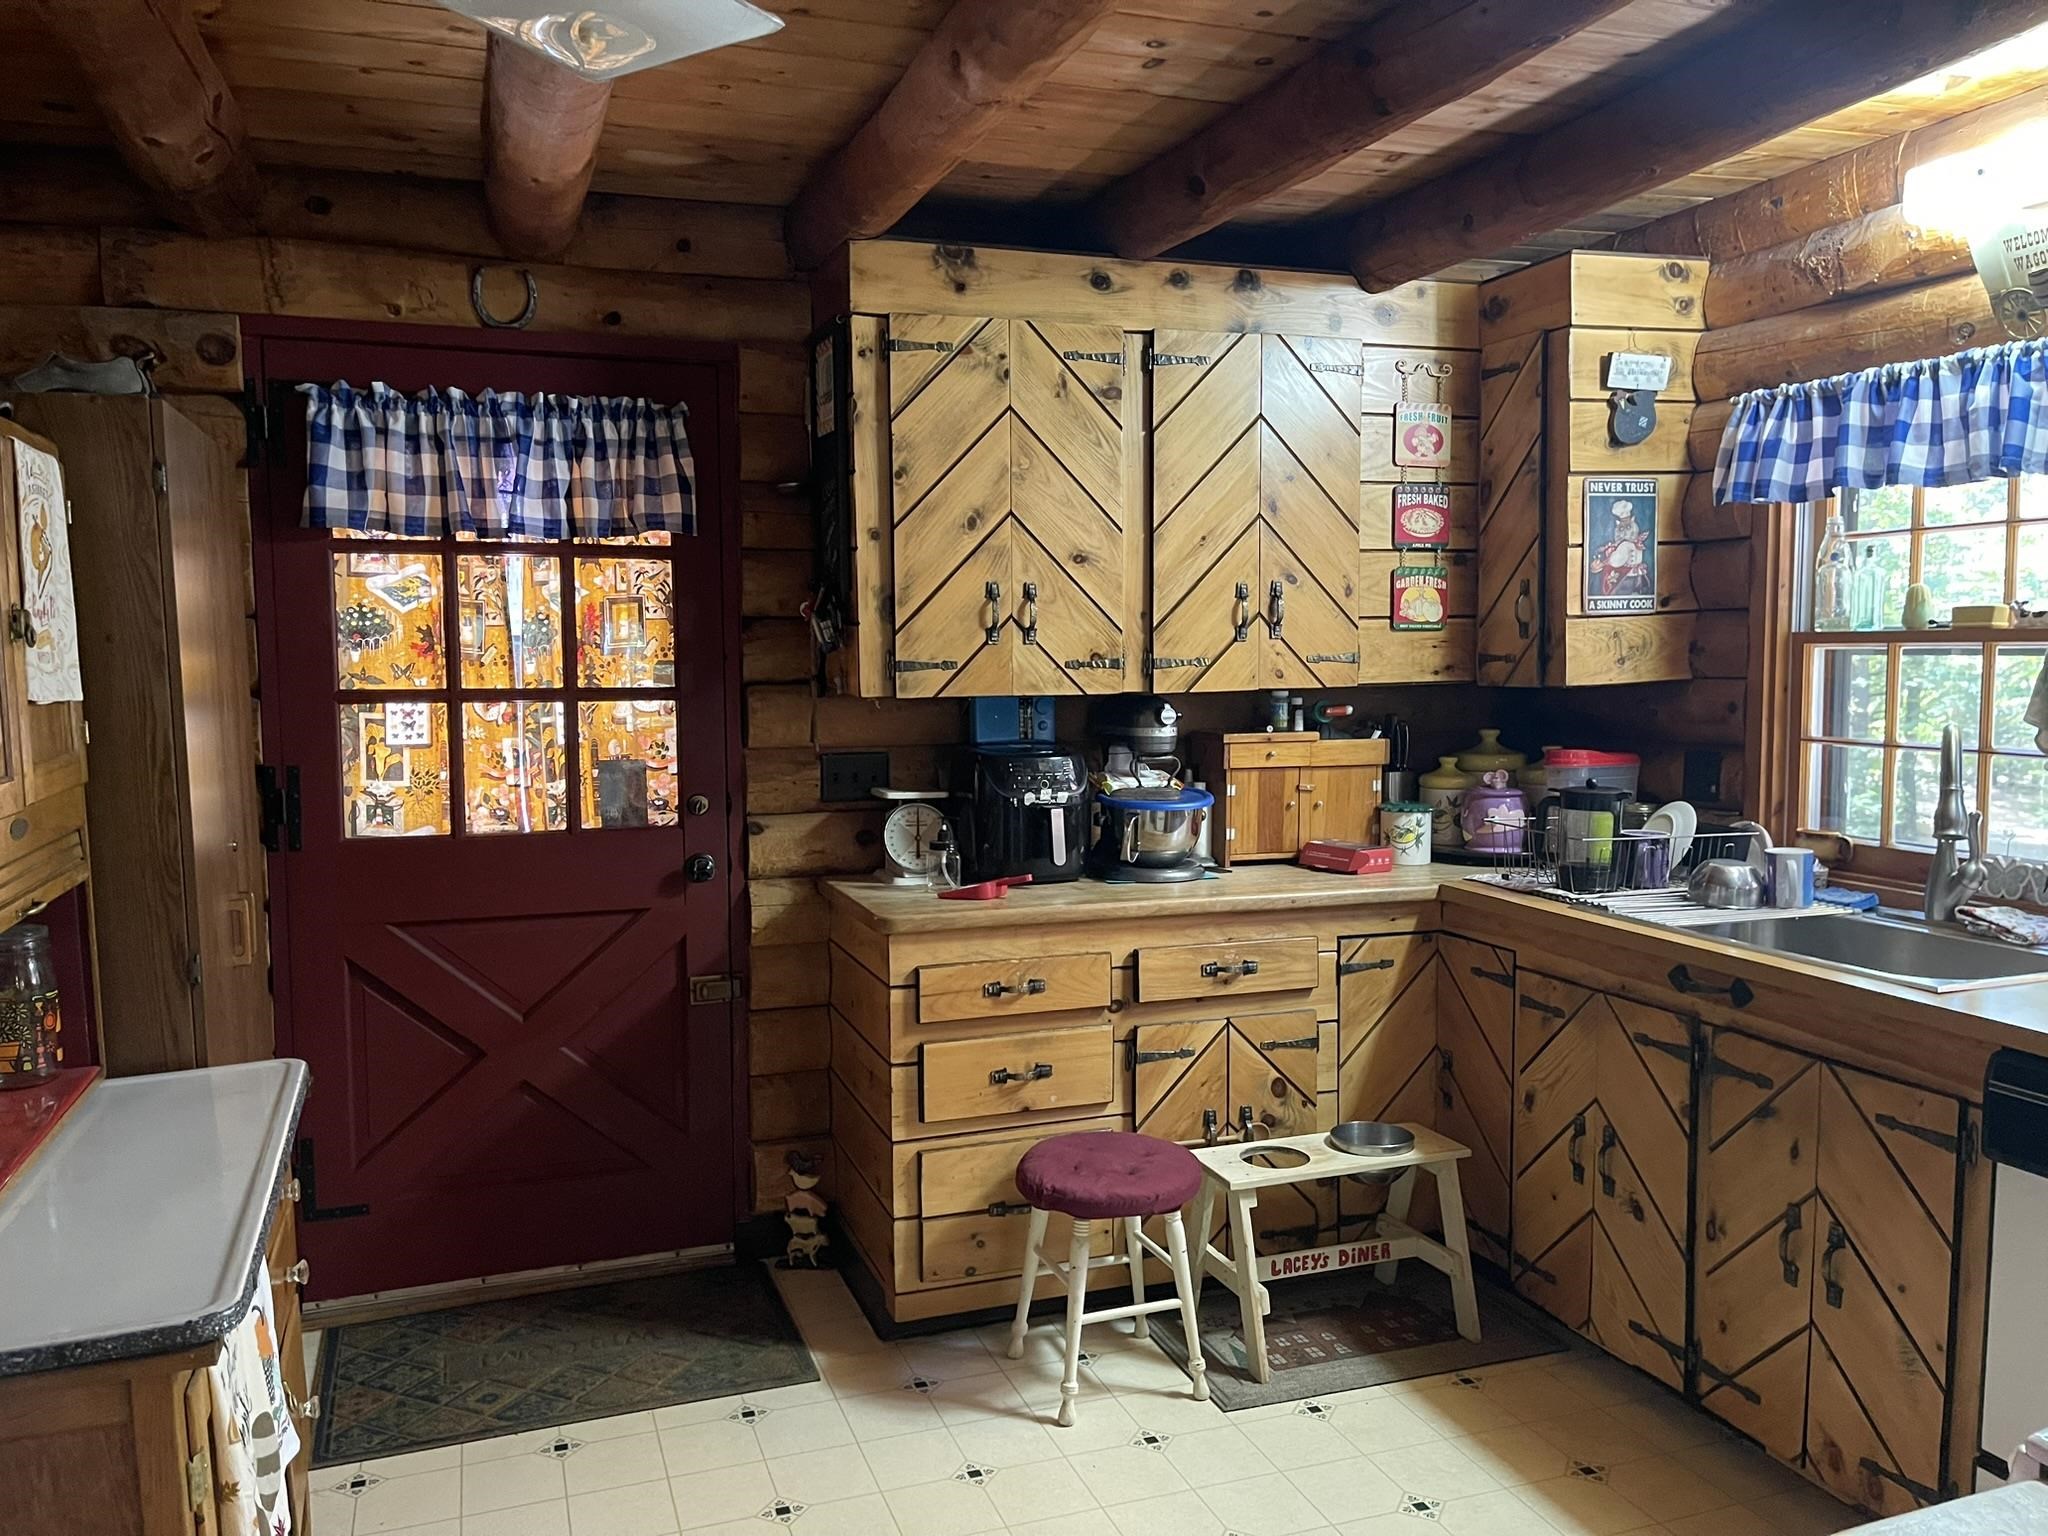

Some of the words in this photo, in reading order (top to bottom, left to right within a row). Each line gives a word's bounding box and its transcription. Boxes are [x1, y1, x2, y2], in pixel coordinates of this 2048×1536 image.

[2014, 249, 2048, 271] WAGO
[1400, 411, 1423, 422] FRESH
[1427, 411, 1448, 424] FRUIT
[1590, 482, 1623, 493] NEVER
[1625, 482, 1655, 493] TRUST
[1397, 493, 1422, 509] FRESH
[1423, 493, 1449, 509] BAKED
[1396, 575, 1424, 589] GARDEN
[1425, 575, 1447, 590] FRESH
[1589, 600, 1595, 610] A
[1596, 599, 1628, 610] SKINNY
[1629, 599, 1653, 609] COOK
